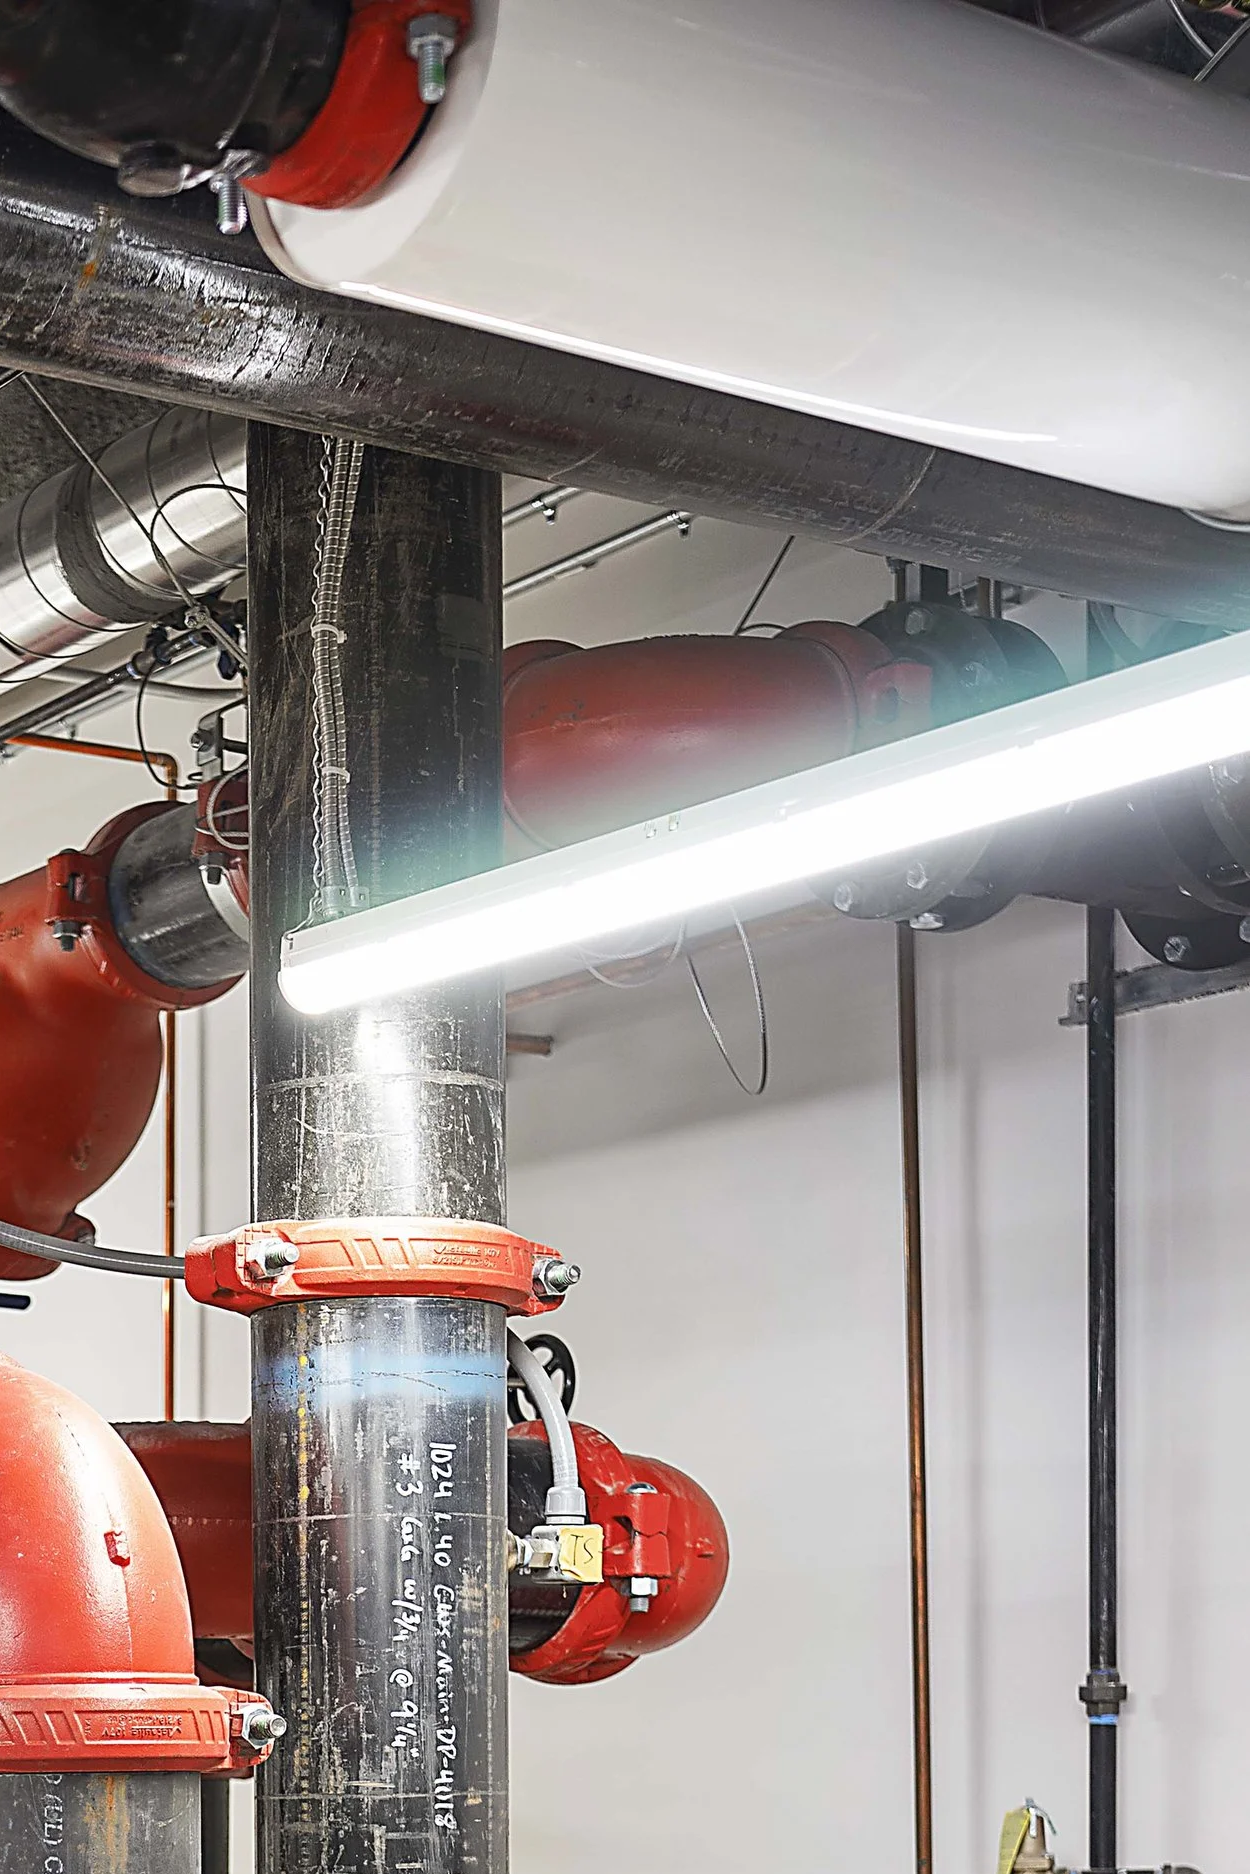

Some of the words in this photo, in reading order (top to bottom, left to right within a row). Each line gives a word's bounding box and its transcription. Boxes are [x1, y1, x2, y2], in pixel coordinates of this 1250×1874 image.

[429, 1441, 457, 1499] 1024
[432, 1511, 454, 1568] L.40
[570, 1533, 594, 1566] TS
